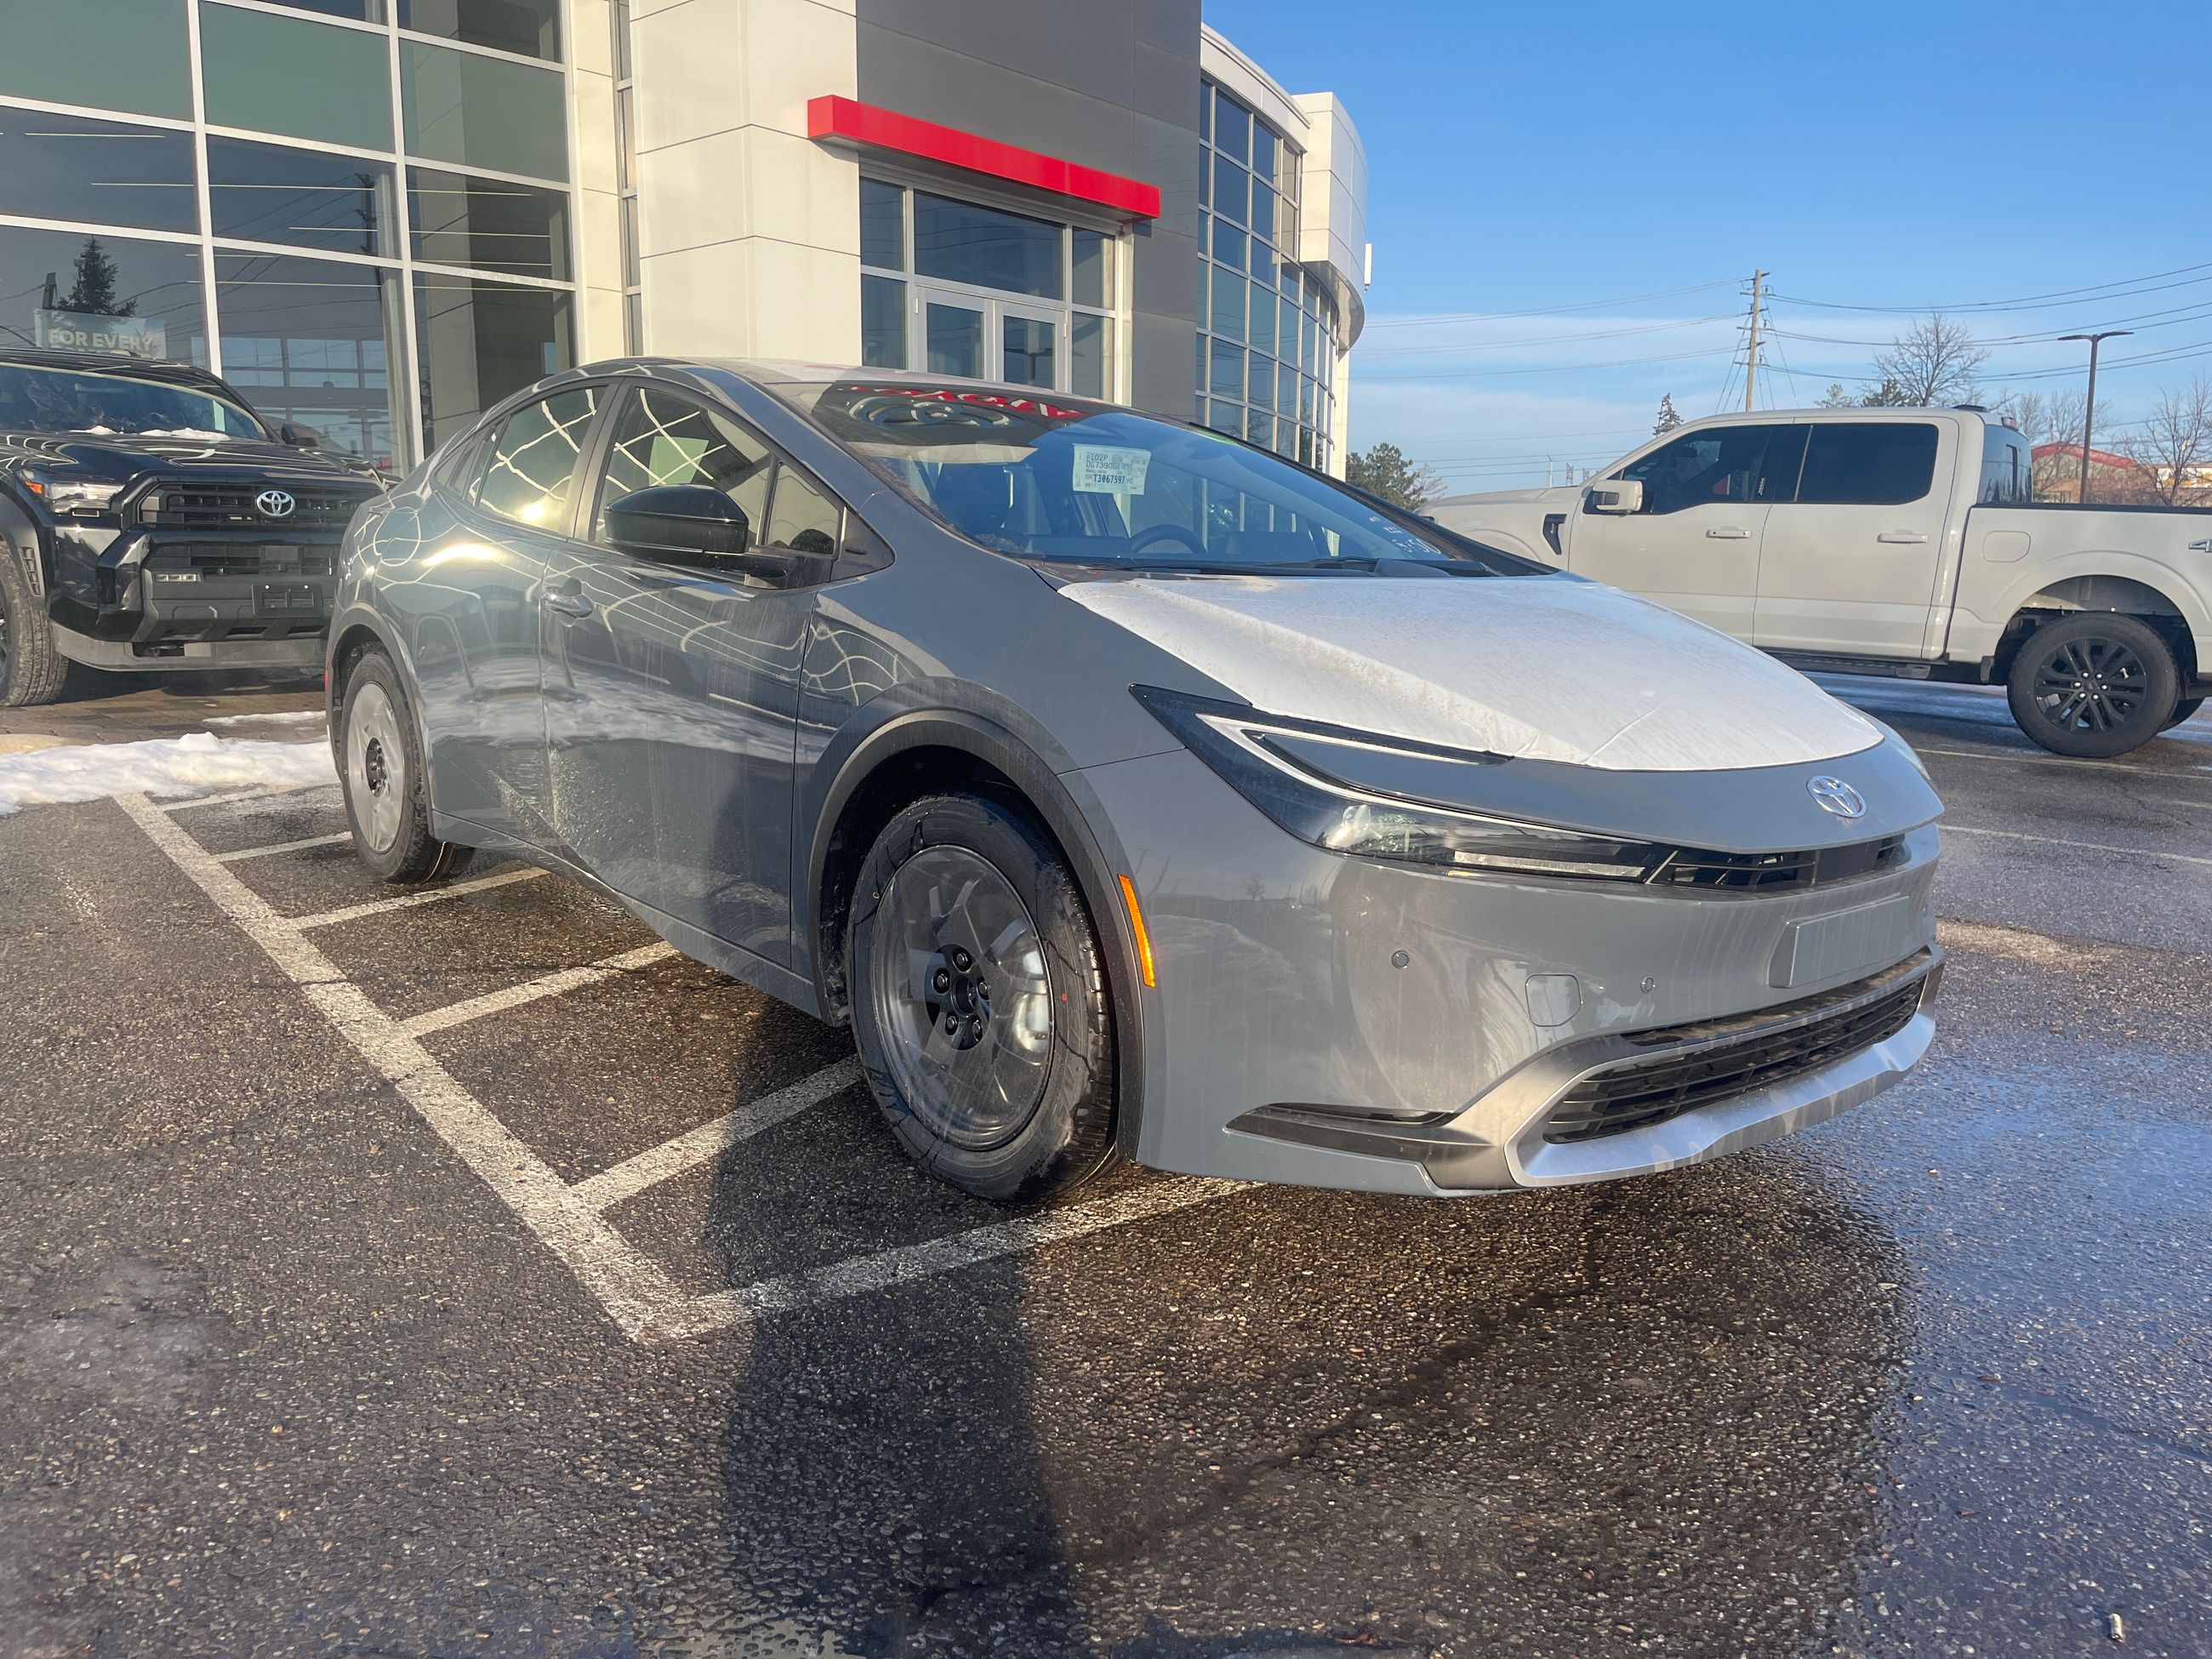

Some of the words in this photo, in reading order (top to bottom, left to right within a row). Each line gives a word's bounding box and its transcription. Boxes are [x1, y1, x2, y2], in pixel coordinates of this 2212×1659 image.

[48, 328, 88, 346] FOR
[92, 333, 152, 351] EVERY
[1093, 474, 1125, 484] T3067597
